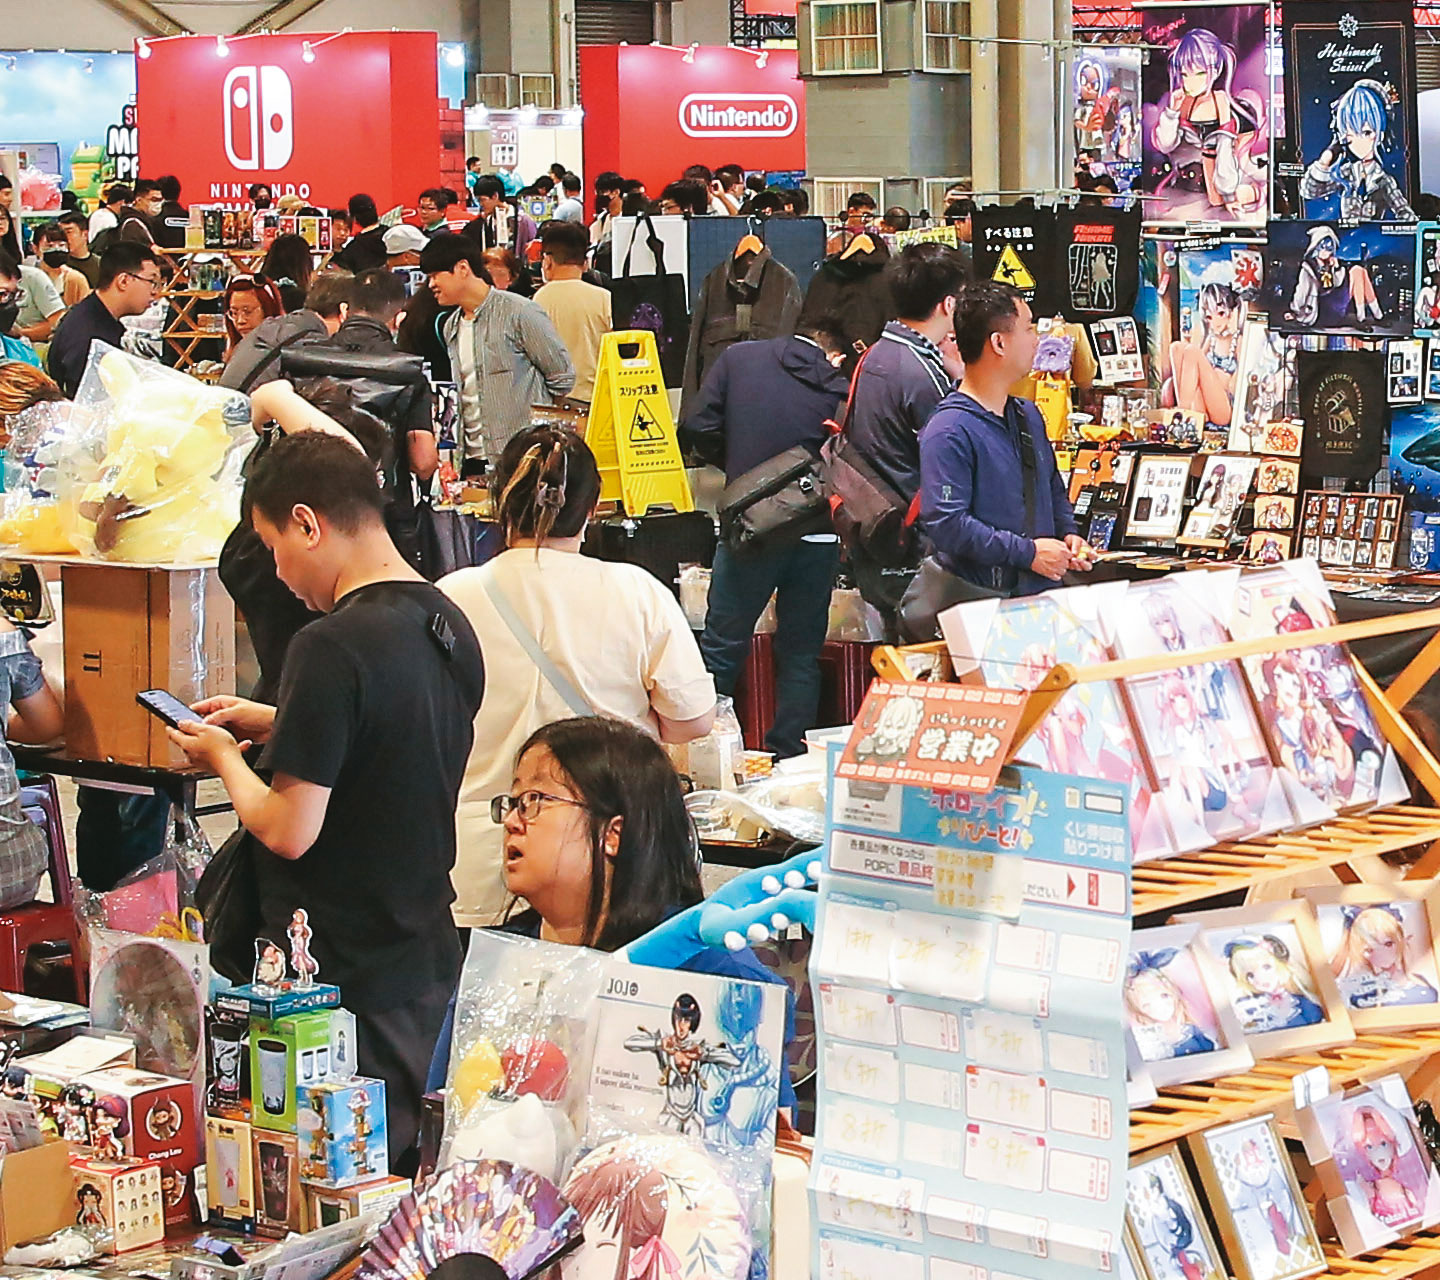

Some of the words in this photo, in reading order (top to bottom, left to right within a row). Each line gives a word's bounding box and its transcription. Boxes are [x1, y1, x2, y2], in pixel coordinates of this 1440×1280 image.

[689, 101, 787, 128] Nintendo
[210, 183, 310, 199] NINTNDO
[916, 727, 1002, 766] 営業中
